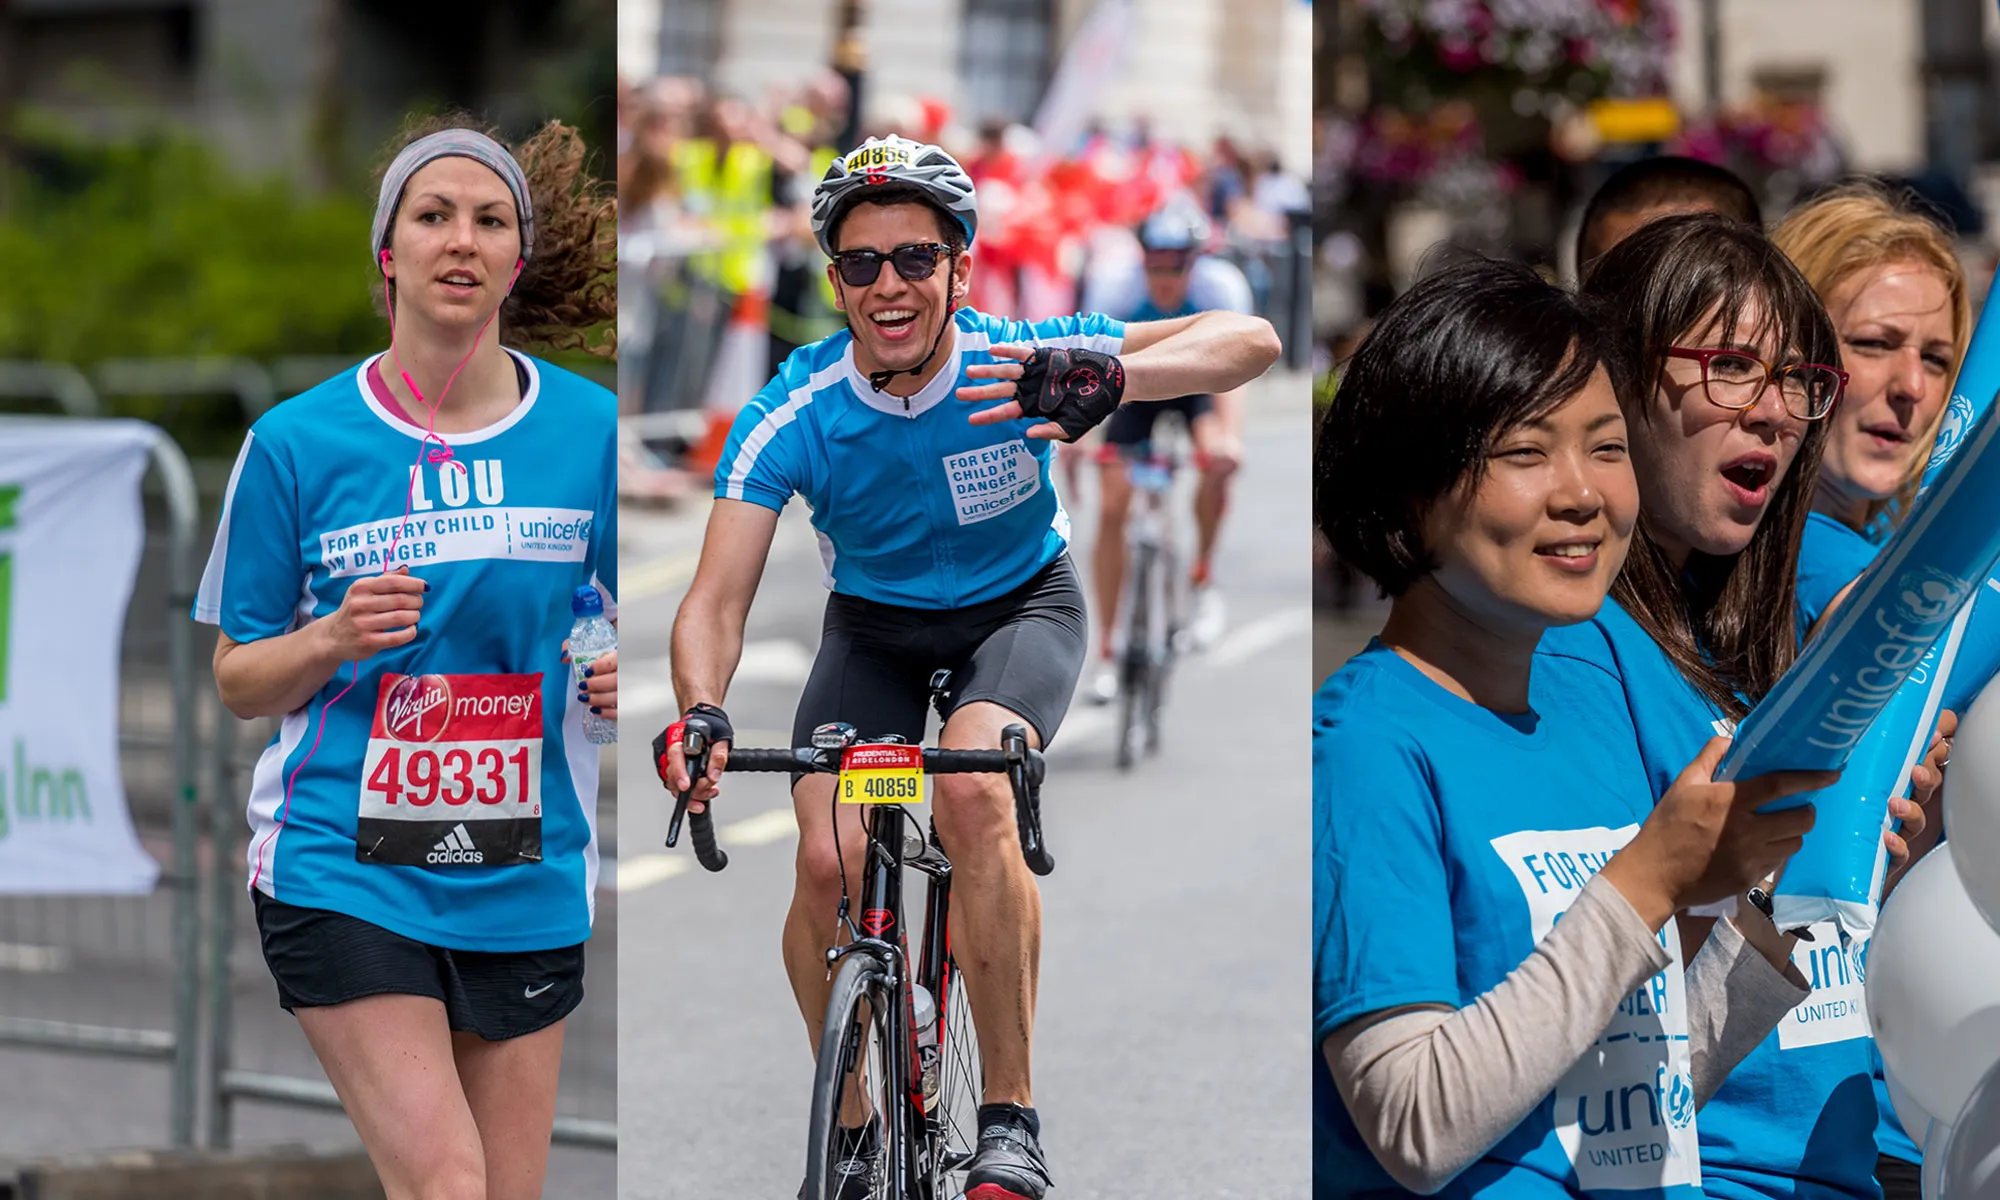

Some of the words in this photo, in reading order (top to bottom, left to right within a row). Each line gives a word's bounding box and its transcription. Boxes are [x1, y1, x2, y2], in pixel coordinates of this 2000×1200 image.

[949, 456, 978, 470] FOR
[981, 443, 1027, 463] EVERY
[952, 465, 998, 482] CHILD
[1002, 458, 1018, 471] IN
[956, 471, 1017, 495] DANGER
[408, 459, 505, 511] LOU
[961, 490, 1017, 516] unicef
[327, 535, 360, 554] FOR
[366, 520, 428, 545] EVERY
[434, 515, 495, 535] CHILD
[519, 516, 582, 541] unicef
[327, 553, 346, 571] IN
[354, 541, 437, 568] DANGER
[1806, 606, 1938, 751] unicef
[390, 676, 447, 737] Virgin
[455, 693, 535, 721] money
[367, 746, 530, 807] 49331
[845, 779, 854, 798] B
[864, 777, 917, 798] 40859
[533, 804, 541, 816] 8
[426, 849, 484, 864] adidas
[1522, 851, 1587, 894] FOR
[1795, 1000, 1848, 1024] UNITED
[1588, 1142, 1664, 1167] UNITED
